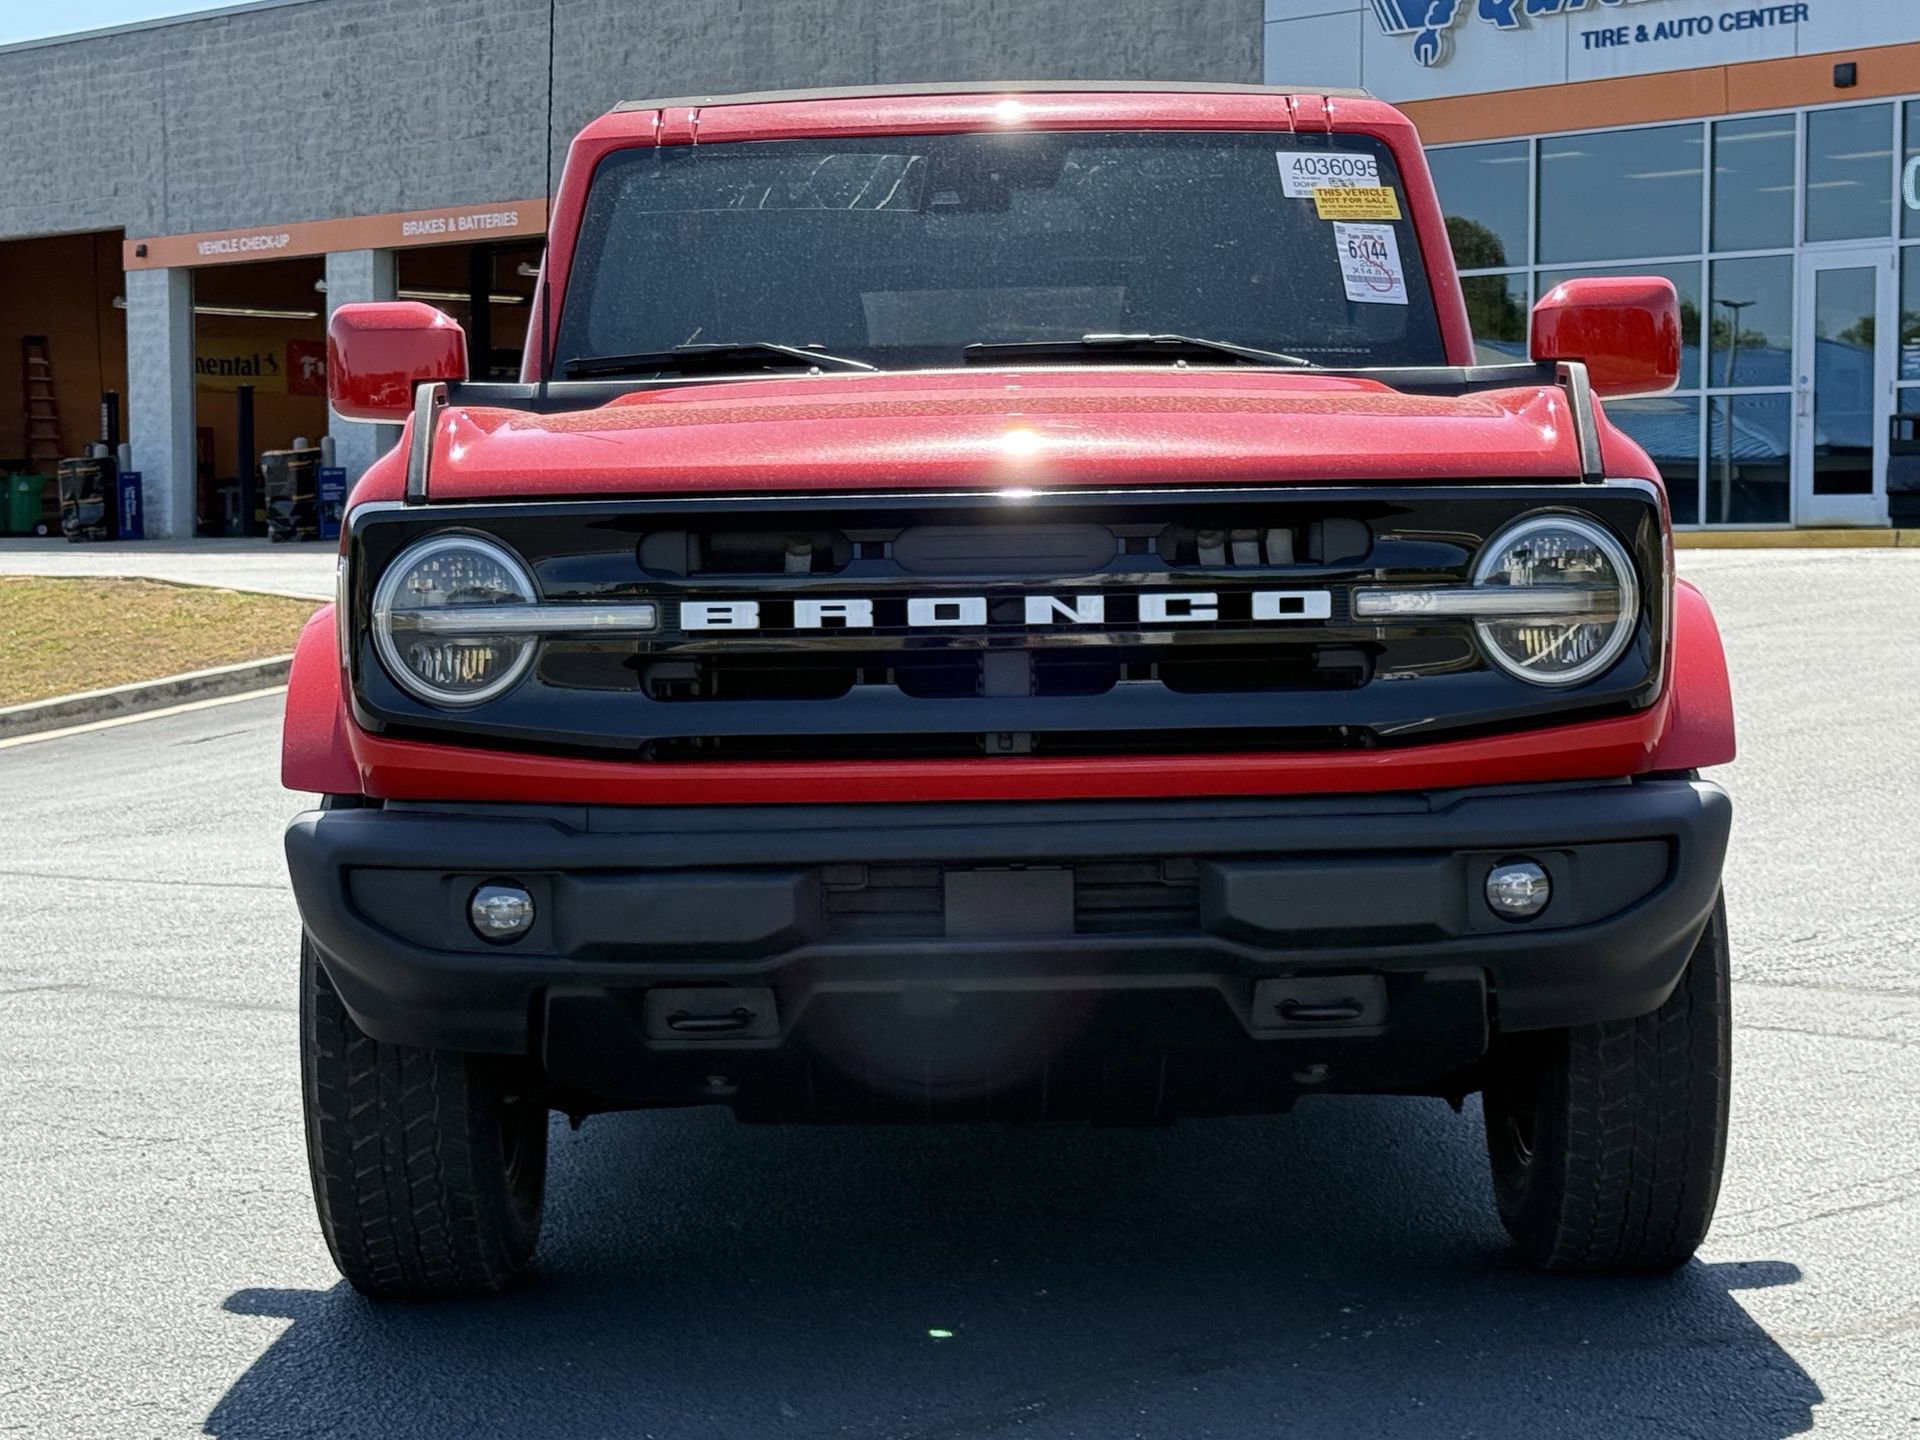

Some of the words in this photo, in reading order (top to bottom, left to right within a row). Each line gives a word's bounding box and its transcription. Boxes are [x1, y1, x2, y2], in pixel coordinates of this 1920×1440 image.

[1581, 27, 1629, 49] TIRE
[1635, 25, 1649, 42] &
[1654, 16, 1713, 40] AUTO
[1719, 3, 1809, 32] CENTER
[1292, 158, 1378, 177] 4036095
[1317, 189, 1342, 197] THIS
[1343, 189, 1389, 197] VEHICLE
[403, 218, 446, 236] BRAKES
[448, 217, 456, 231] &
[458, 212, 519, 231] BATTERIES
[197, 238, 238, 255] VEHICLE
[239, 233, 290, 251] CHECK-UP
[679, 589, 1333, 632] BRONCO
